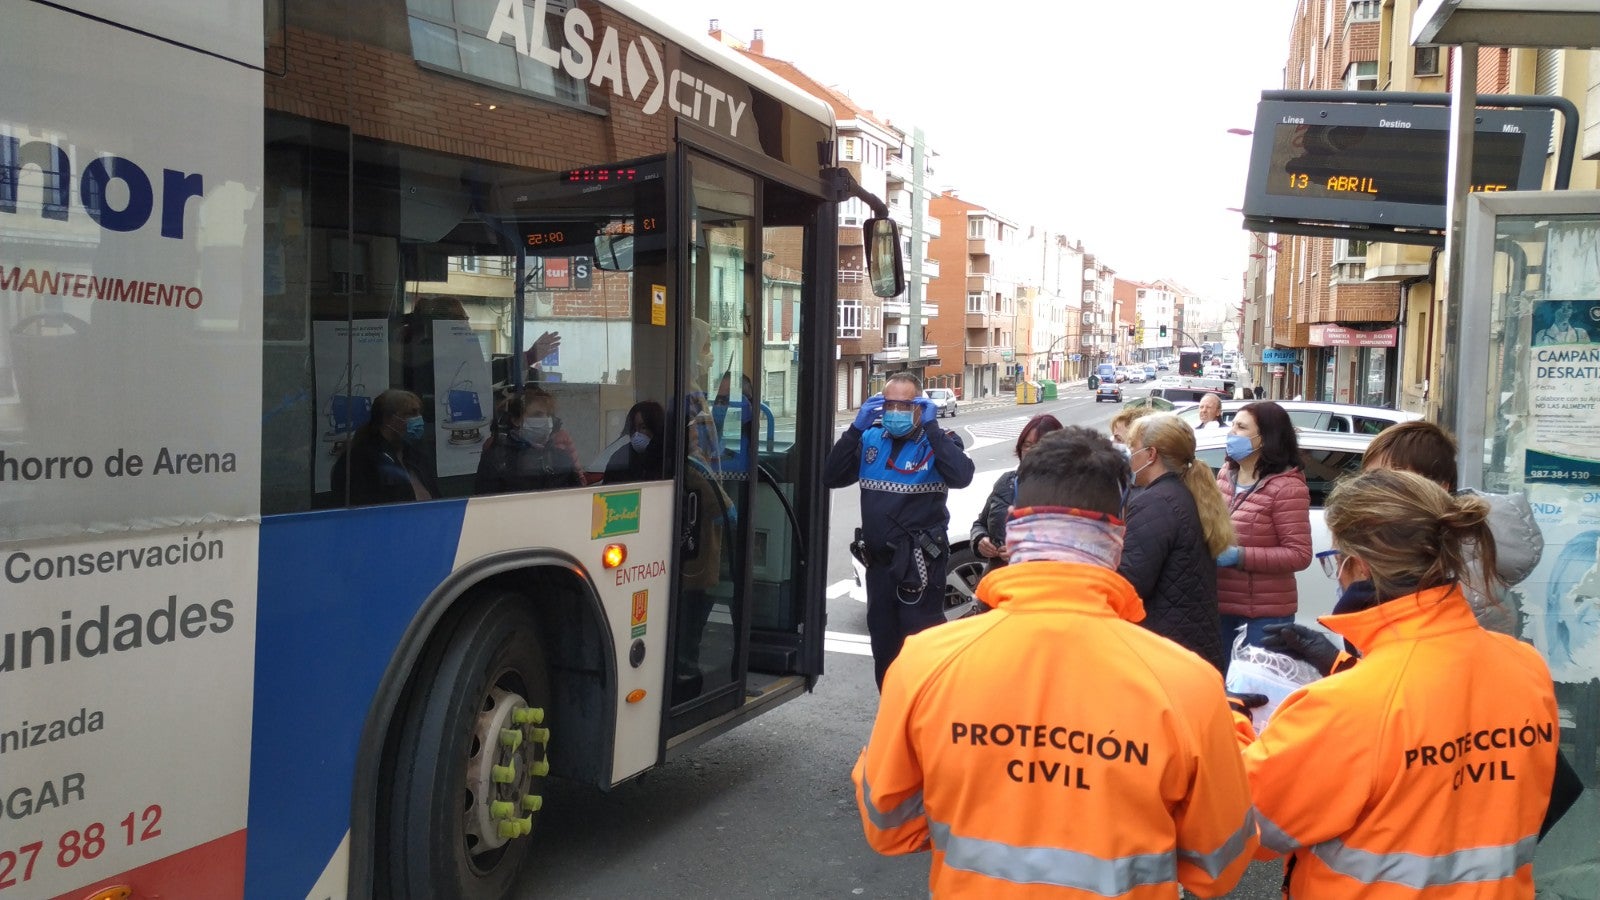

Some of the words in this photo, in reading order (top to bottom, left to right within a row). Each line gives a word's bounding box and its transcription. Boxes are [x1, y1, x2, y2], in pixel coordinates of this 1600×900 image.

[486, 0, 623, 97] ALSA
[1379, 119, 1411, 129] Destino
[1502, 124, 1521, 133] Min.
[1290, 173, 1309, 189] 13
[1327, 176, 1377, 193] ABRIL
[0, 265, 203, 310] MANTENIMIENTO
[1537, 367, 1600, 379] DESRATI
[0, 450, 93, 481] horro
[104, 448, 144, 477] de
[152, 447, 236, 475] Arena
[1530, 470, 1549, 478] 987
[1551, 470, 1569, 479] 384
[1571, 471, 1590, 480] 530
[1530, 502, 1563, 514] NDA
[5, 531, 224, 584] Conservación
[615, 560, 667, 586] ENTRADA
[952, 722, 1149, 766] PROTECCIÓN
[1405, 719, 1553, 770] PROTECCIÓN
[1007, 759, 1090, 790] CIVIL
[1453, 760, 1515, 791] CIVIL
[0, 772, 85, 820] GAR
[0, 841, 43, 889] 27
[56, 822, 105, 868] 88
[121, 804, 162, 846] 12
